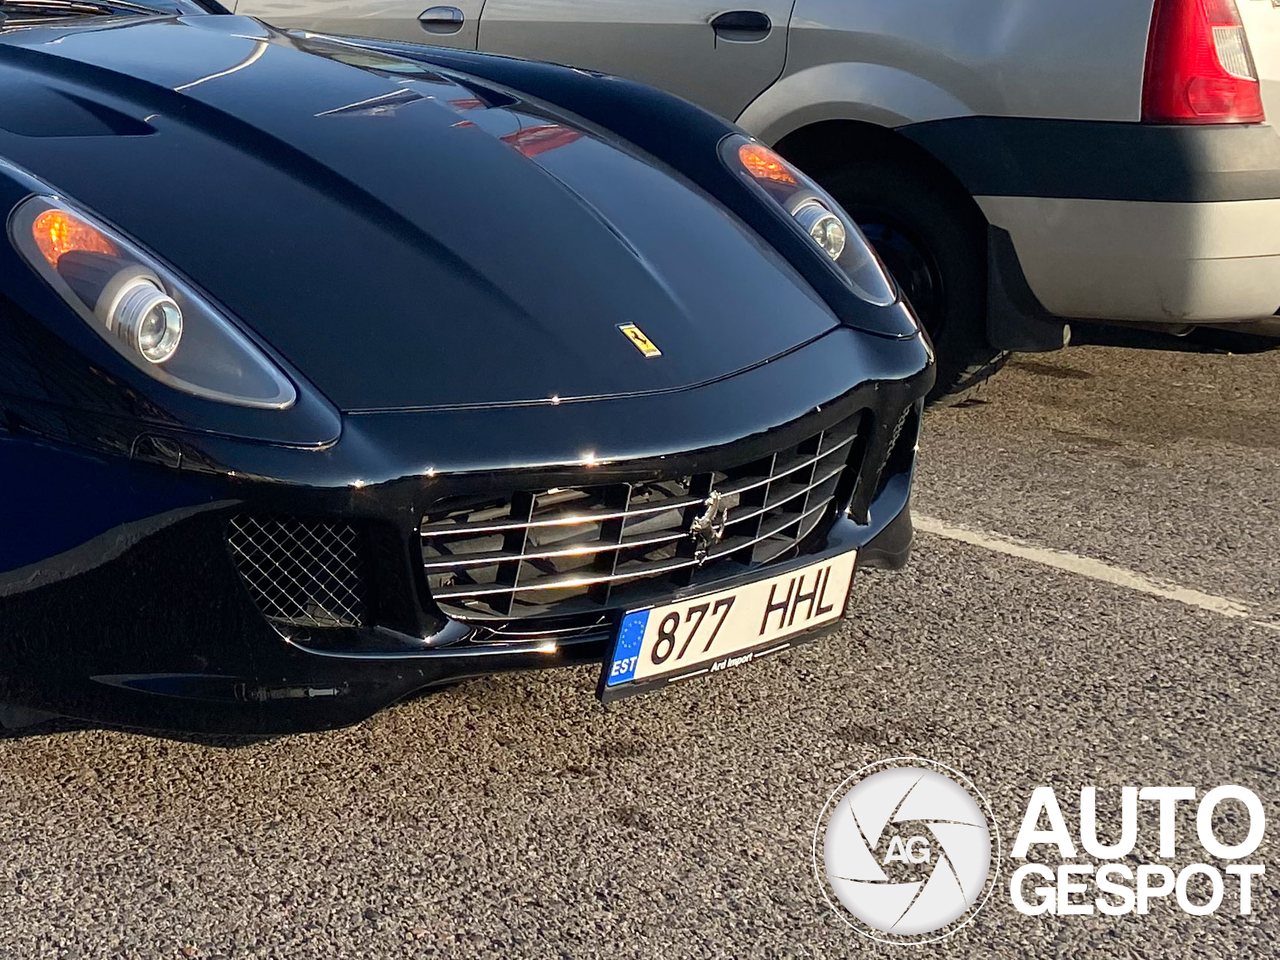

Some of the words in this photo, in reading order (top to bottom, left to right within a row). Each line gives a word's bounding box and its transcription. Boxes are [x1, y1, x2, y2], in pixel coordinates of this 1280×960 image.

[650, 595, 737, 665] 877
[759, 565, 833, 637] HHL
[610, 655, 638, 677] EST
[727, 652, 754, 668] Import
